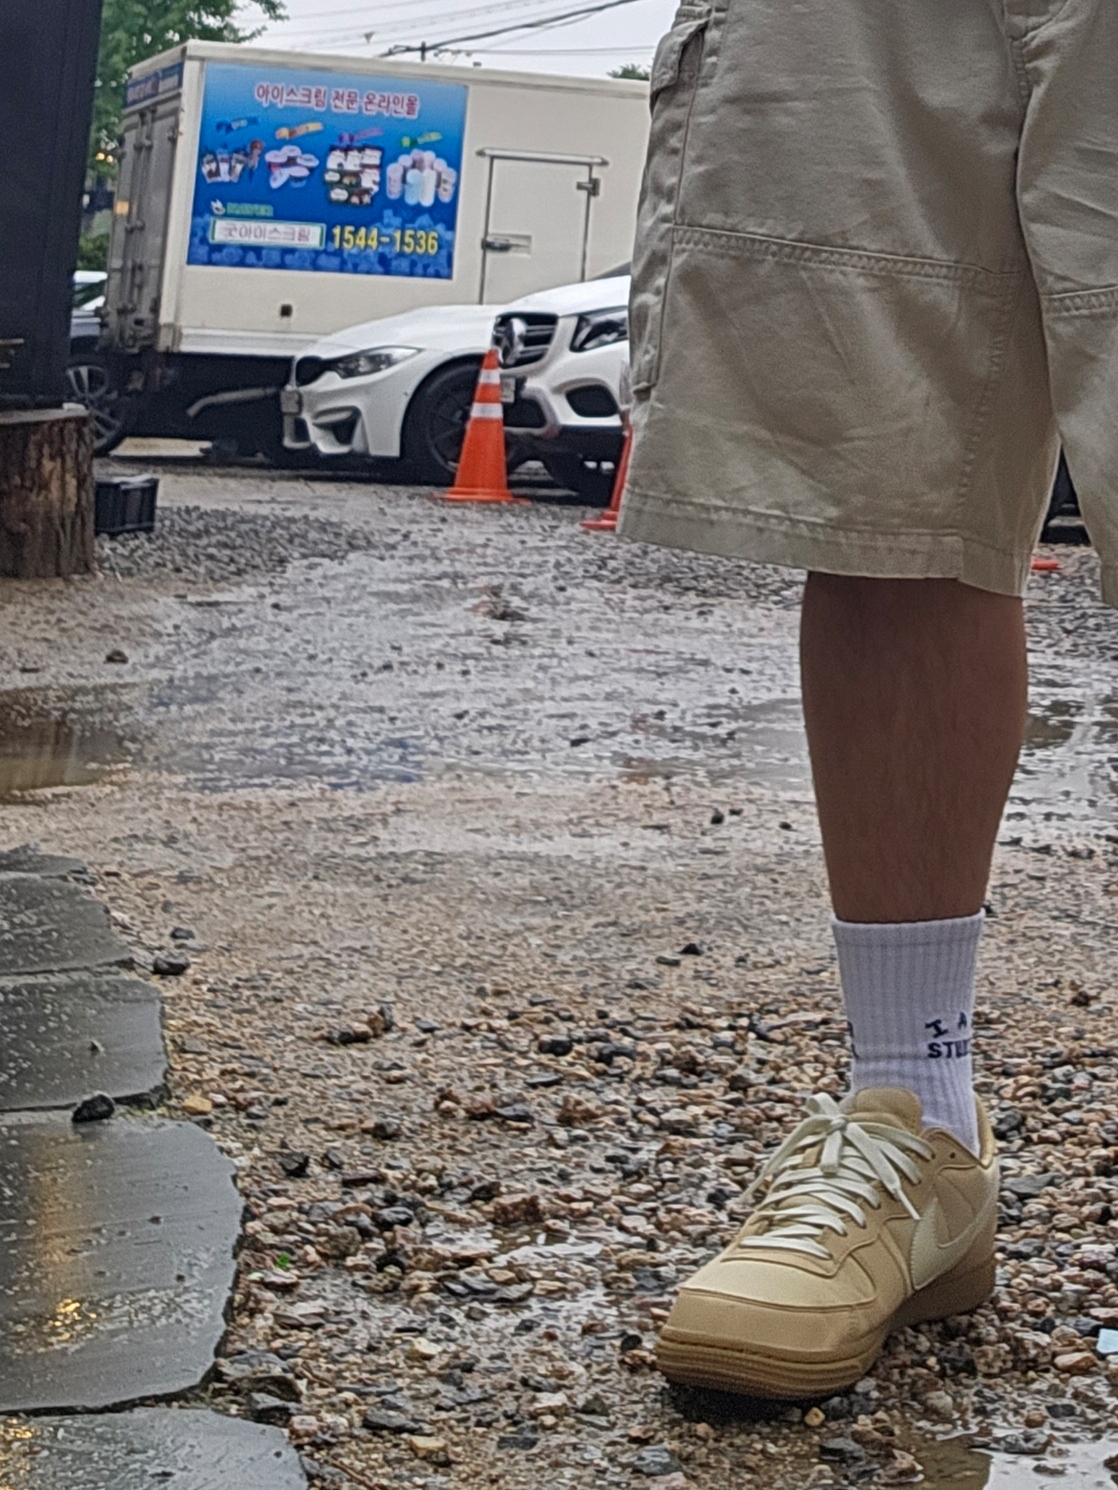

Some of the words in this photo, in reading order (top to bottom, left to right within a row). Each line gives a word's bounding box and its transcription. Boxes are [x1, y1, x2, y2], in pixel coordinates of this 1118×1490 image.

[255, 83, 327, 110] 아이스크림
[331, 89, 359, 112] 전문
[363, 91, 419, 117] 온라인몰
[332, 224, 438, 256] 1544-1536
